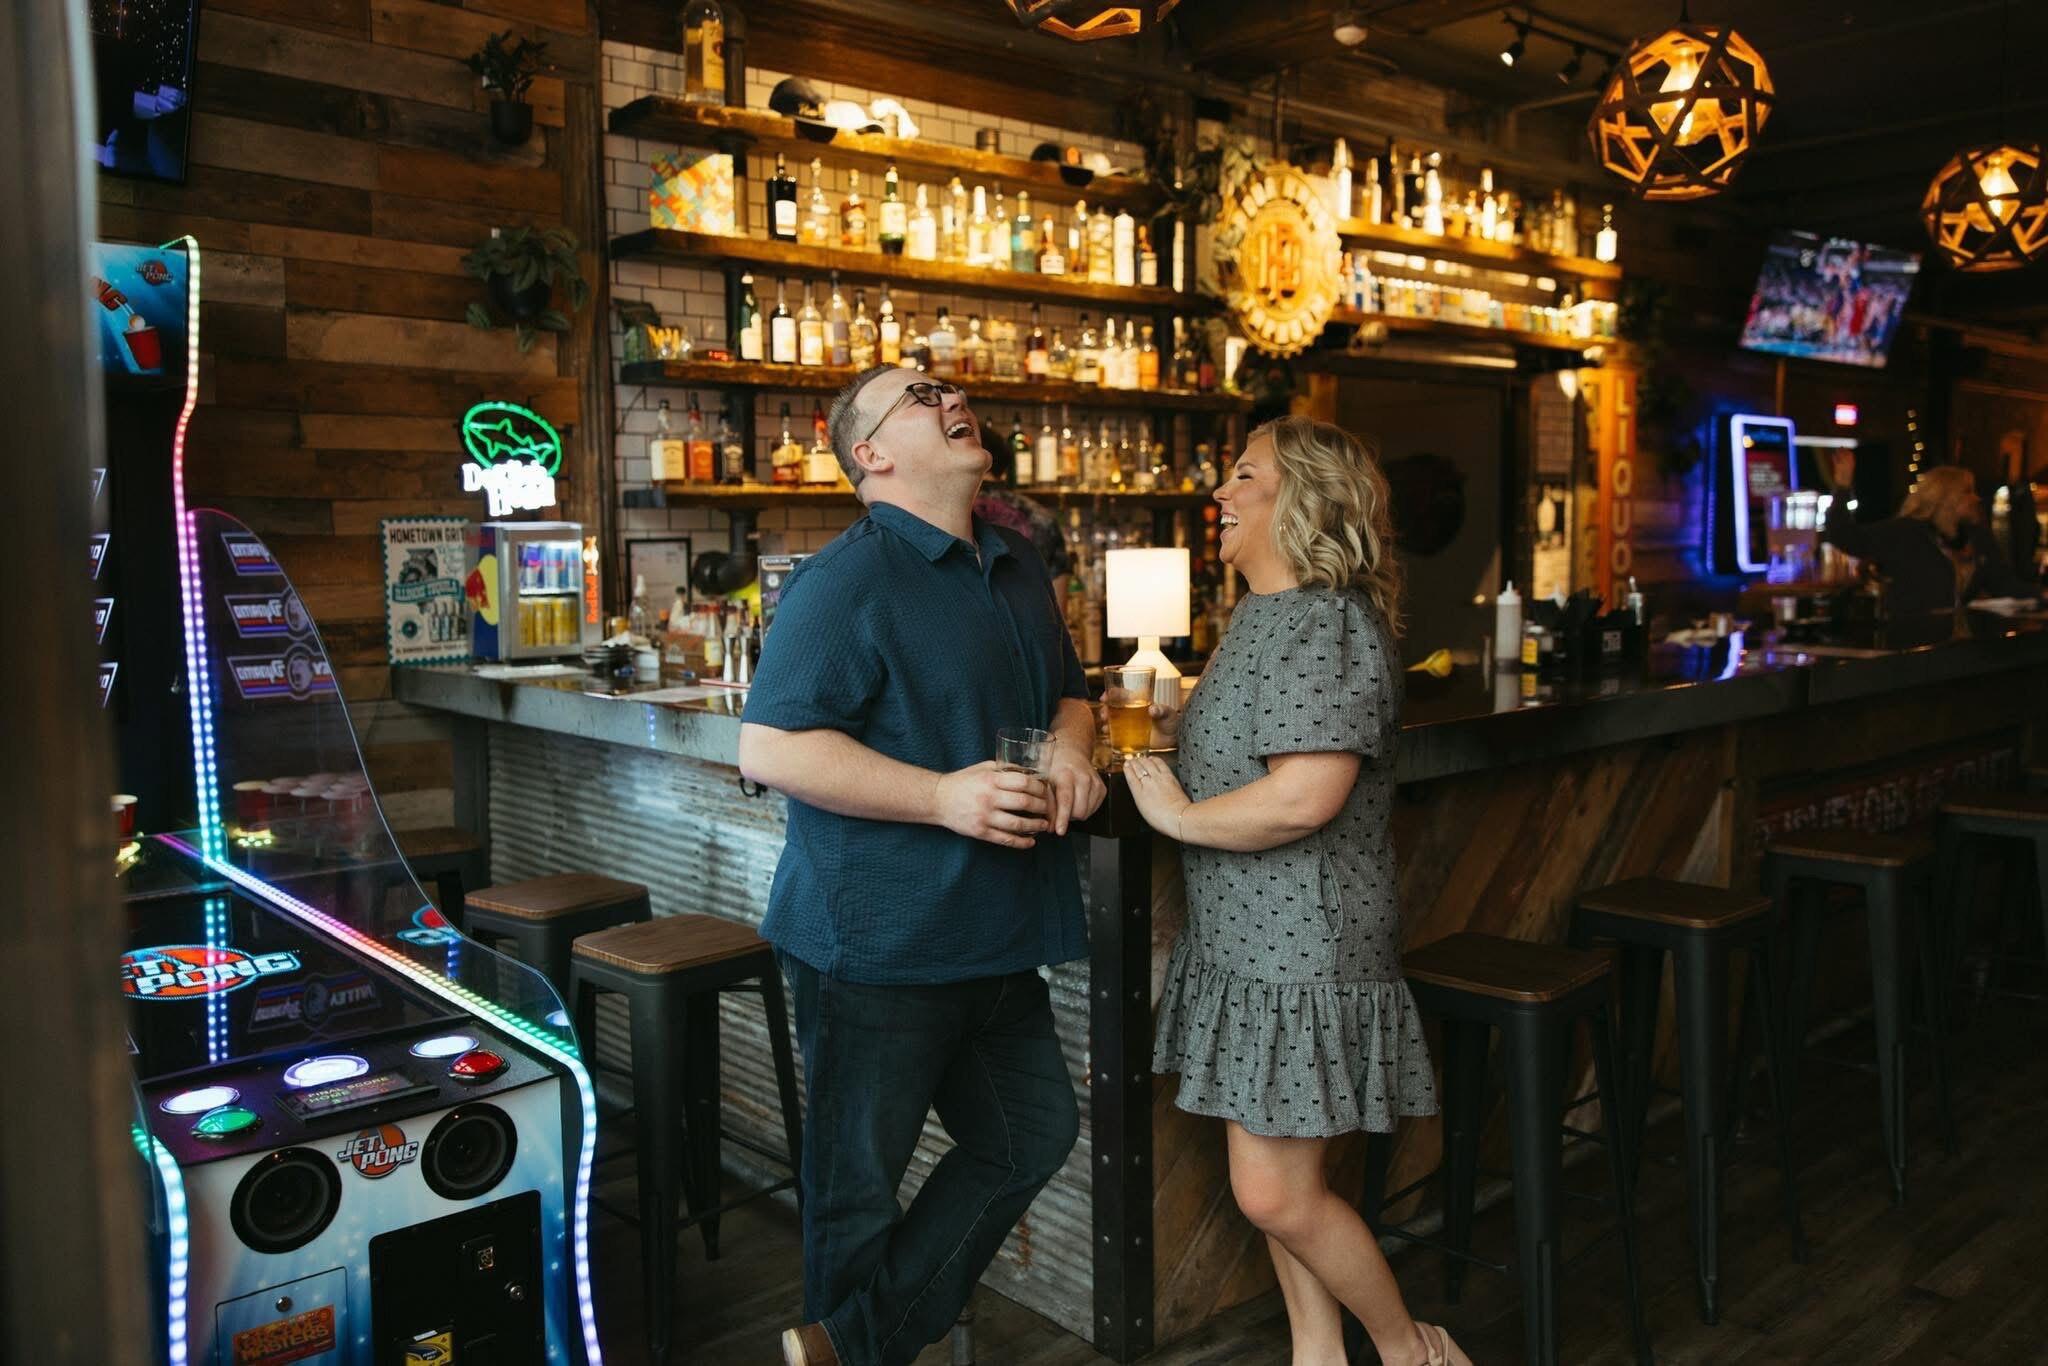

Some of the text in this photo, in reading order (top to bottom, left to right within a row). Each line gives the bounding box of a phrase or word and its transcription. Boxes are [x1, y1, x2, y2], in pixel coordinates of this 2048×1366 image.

[390, 527, 443, 544] HOMETOWN
[136, 952, 299, 995] PONG
[347, 1077, 389, 1089] SCORE
[338, 1135, 379, 1158] JET
[361, 1143, 417, 1170] PONG
